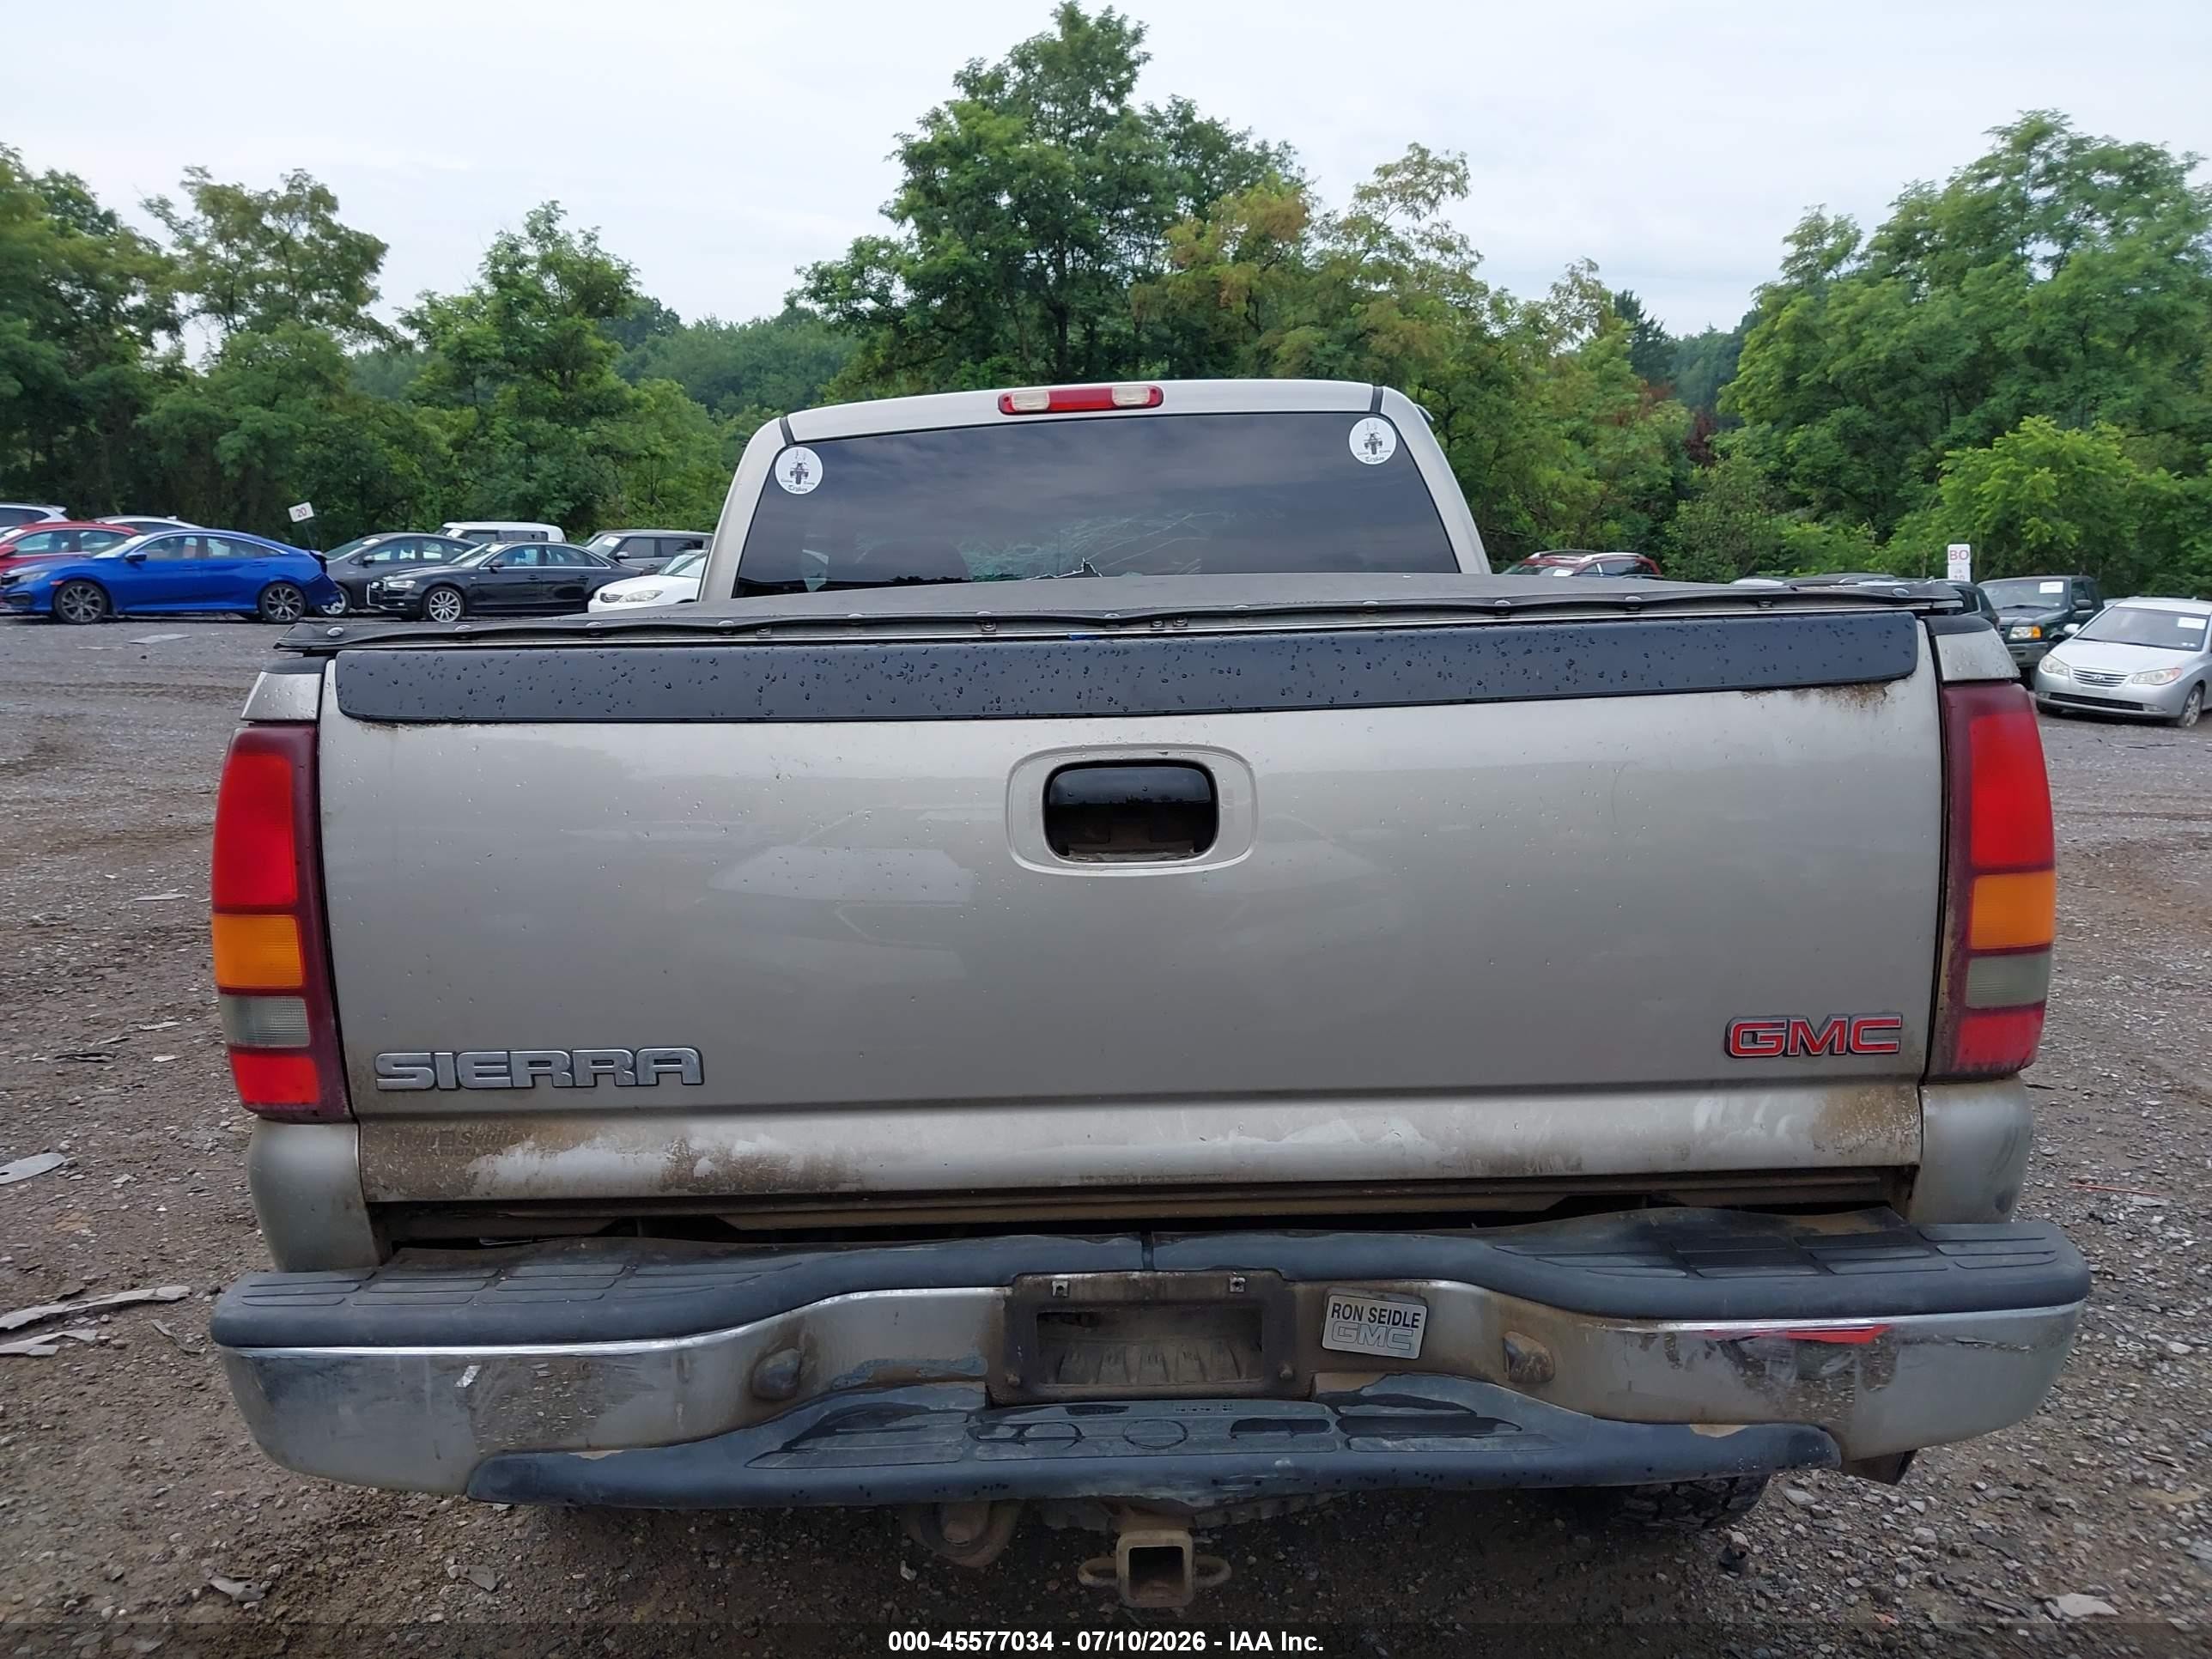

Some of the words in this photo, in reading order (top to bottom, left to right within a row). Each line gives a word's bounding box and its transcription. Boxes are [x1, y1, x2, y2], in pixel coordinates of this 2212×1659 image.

[295, 507, 307, 518] 20
[1724, 1012, 1903, 1058] GMC
[374, 1046, 704, 1091] SIERRA
[1331, 1303, 1364, 1322] RON
[1368, 1307, 1421, 1328] SEIDLE
[1332, 1321, 1414, 1351] GMC
